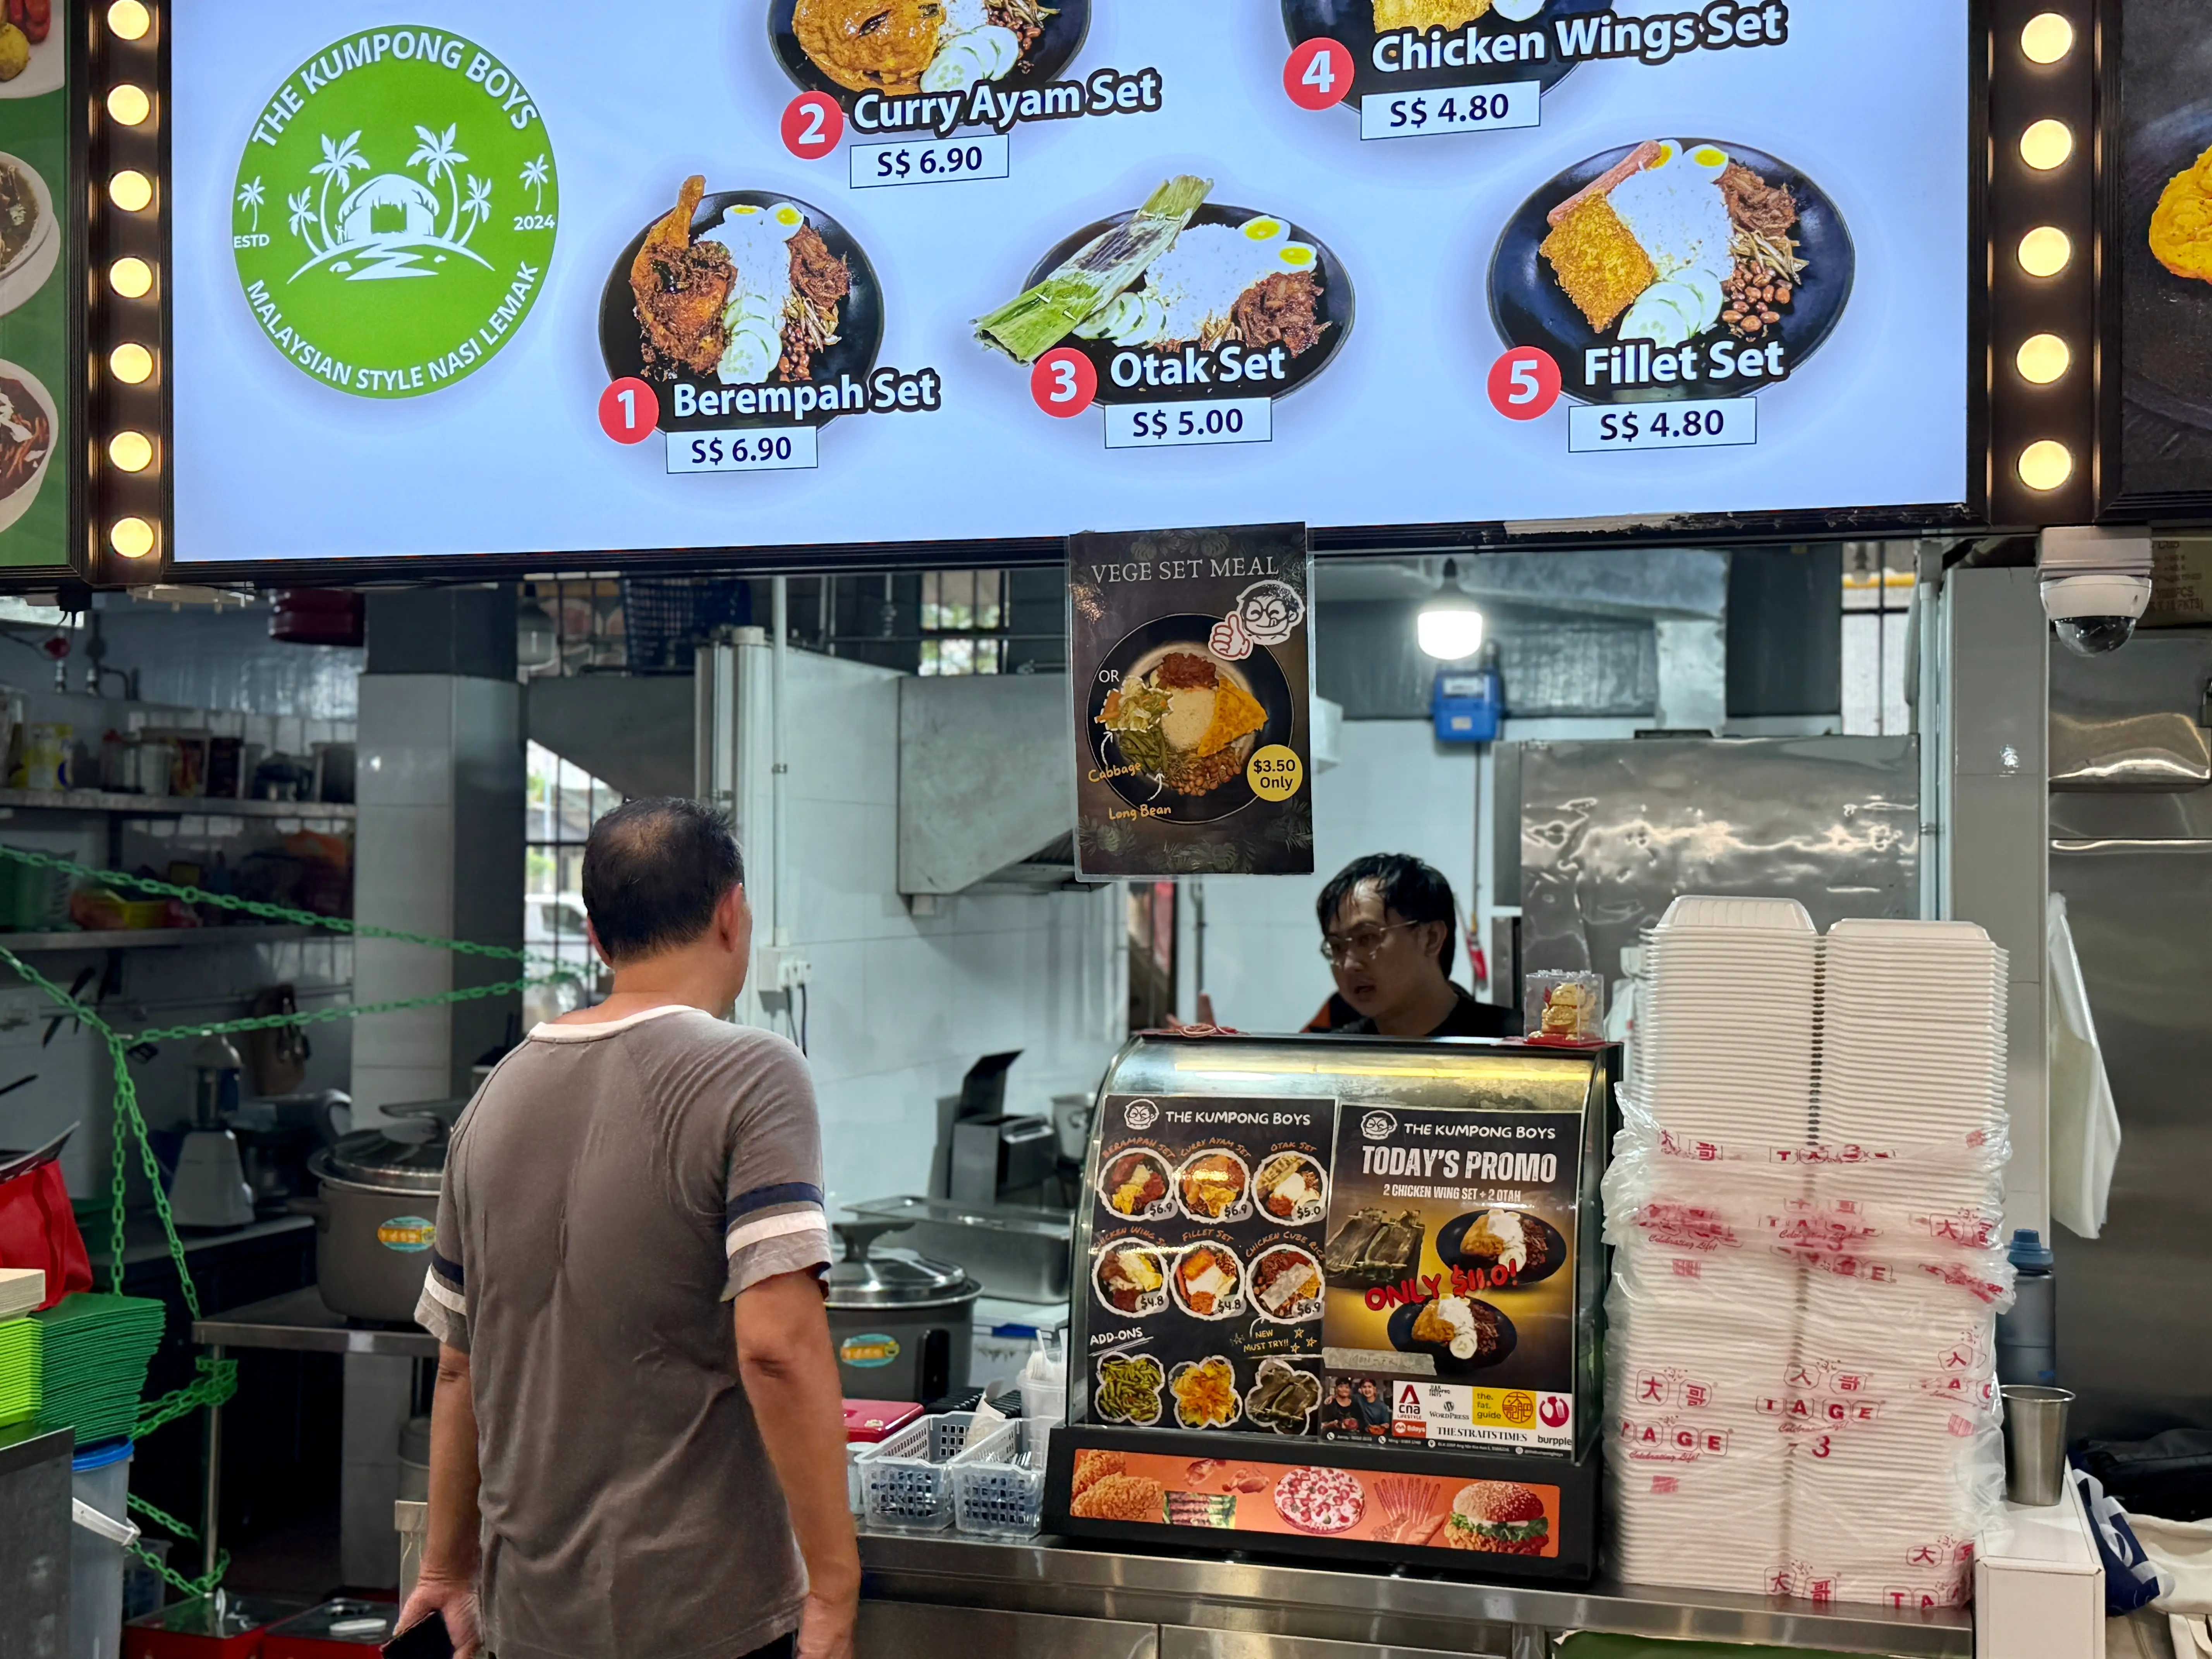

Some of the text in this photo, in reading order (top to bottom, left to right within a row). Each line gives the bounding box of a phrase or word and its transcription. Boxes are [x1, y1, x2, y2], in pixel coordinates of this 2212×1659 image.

[1372, 7, 1783, 74] Chicken Wings Set
[1302, 51, 1334, 93] 4
[252, 31, 538, 146] THE KUMPONG BOYS
[855, 74, 1157, 133] Curry Ayam Set
[1390, 93, 1509, 129] S$ 4.80
[799, 103, 825, 144] 2
[878, 146, 982, 178] S$ 6.90
[514, 215, 555, 231] 2024
[234, 234, 270, 249] ESTD
[247, 260, 539, 390] MALAYSIAN STYLE NASI LEMAK
[1111, 346, 1285, 387] Otak Set
[1585, 340, 1784, 385] Fillet Set
[1050, 360, 1077, 402] 3
[1508, 360, 1538, 404] 5
[674, 372, 935, 420] Berempah Set
[617, 389, 635, 429] 1
[1133, 408, 1243, 439] S$ 5.00
[1600, 409, 1724, 442] S$ 4.80
[692, 436, 792, 465] S$ 6.90
[1092, 556, 1279, 583] VEGE SET MEAL
[1099, 670, 1119, 682] OR
[1088, 761, 1141, 783] Cabbage
[1253, 760, 1295, 773] $3.50
[1260, 776, 1293, 791] Only
[1109, 805, 1171, 821] Long Bean
[1166, 1111, 1310, 1125] THE KUMPONG BOYS
[1404, 1123, 1556, 1139] THE KUMPONG BOYS
[1158, 1144, 1175, 1157] SET
[1181, 1137, 1251, 1157] CURRY AYAM SET
[1271, 1142, 1317, 1152] OTAK SET
[1362, 1145, 1556, 1182] TODAY'S PROMO
[1384, 1184, 1389, 1196] 2
[1392, 1185, 1431, 1199] CHICKEN
[1434, 1187, 1459, 1200] WING
[1462, 1188, 1478, 1200] SET
[1488, 1189, 1494, 1201] 2
[1496, 1190, 1521, 1202] OTAH
[1150, 1203, 1172, 1217] $6.9
[1225, 1202, 1247, 1217] $6.9
[1297, 1206, 1321, 1219] $5.0
[1130, 1226, 1155, 1239] WING
[1183, 1229, 1234, 1243] FILLET SET
[1245, 1232, 1279, 1257] CHICKEN
[1283, 1231, 1308, 1243] CUBE
[1365, 1273, 1441, 1311] ONLY
[1140, 1296, 1164, 1309] $4.8
[1218, 1298, 1242, 1310] $4.8
[1297, 1301, 1321, 1316] $6.9
[1090, 1327, 1143, 1345] ADD-ONS
[1255, 1329, 1273, 1338] NEW
[1243, 1339, 1289, 1353] MUST TRY!!
[1641, 1376, 1706, 1406] 大哥
[1399, 1405, 1420, 1414] cna
[1477, 1411, 1501, 1419] guide
[1764, 1399, 1874, 1420] TAGE
[1437, 1427, 1527, 1442] THE STRAITS TIMES
[1538, 1435, 1572, 1446] burpple
